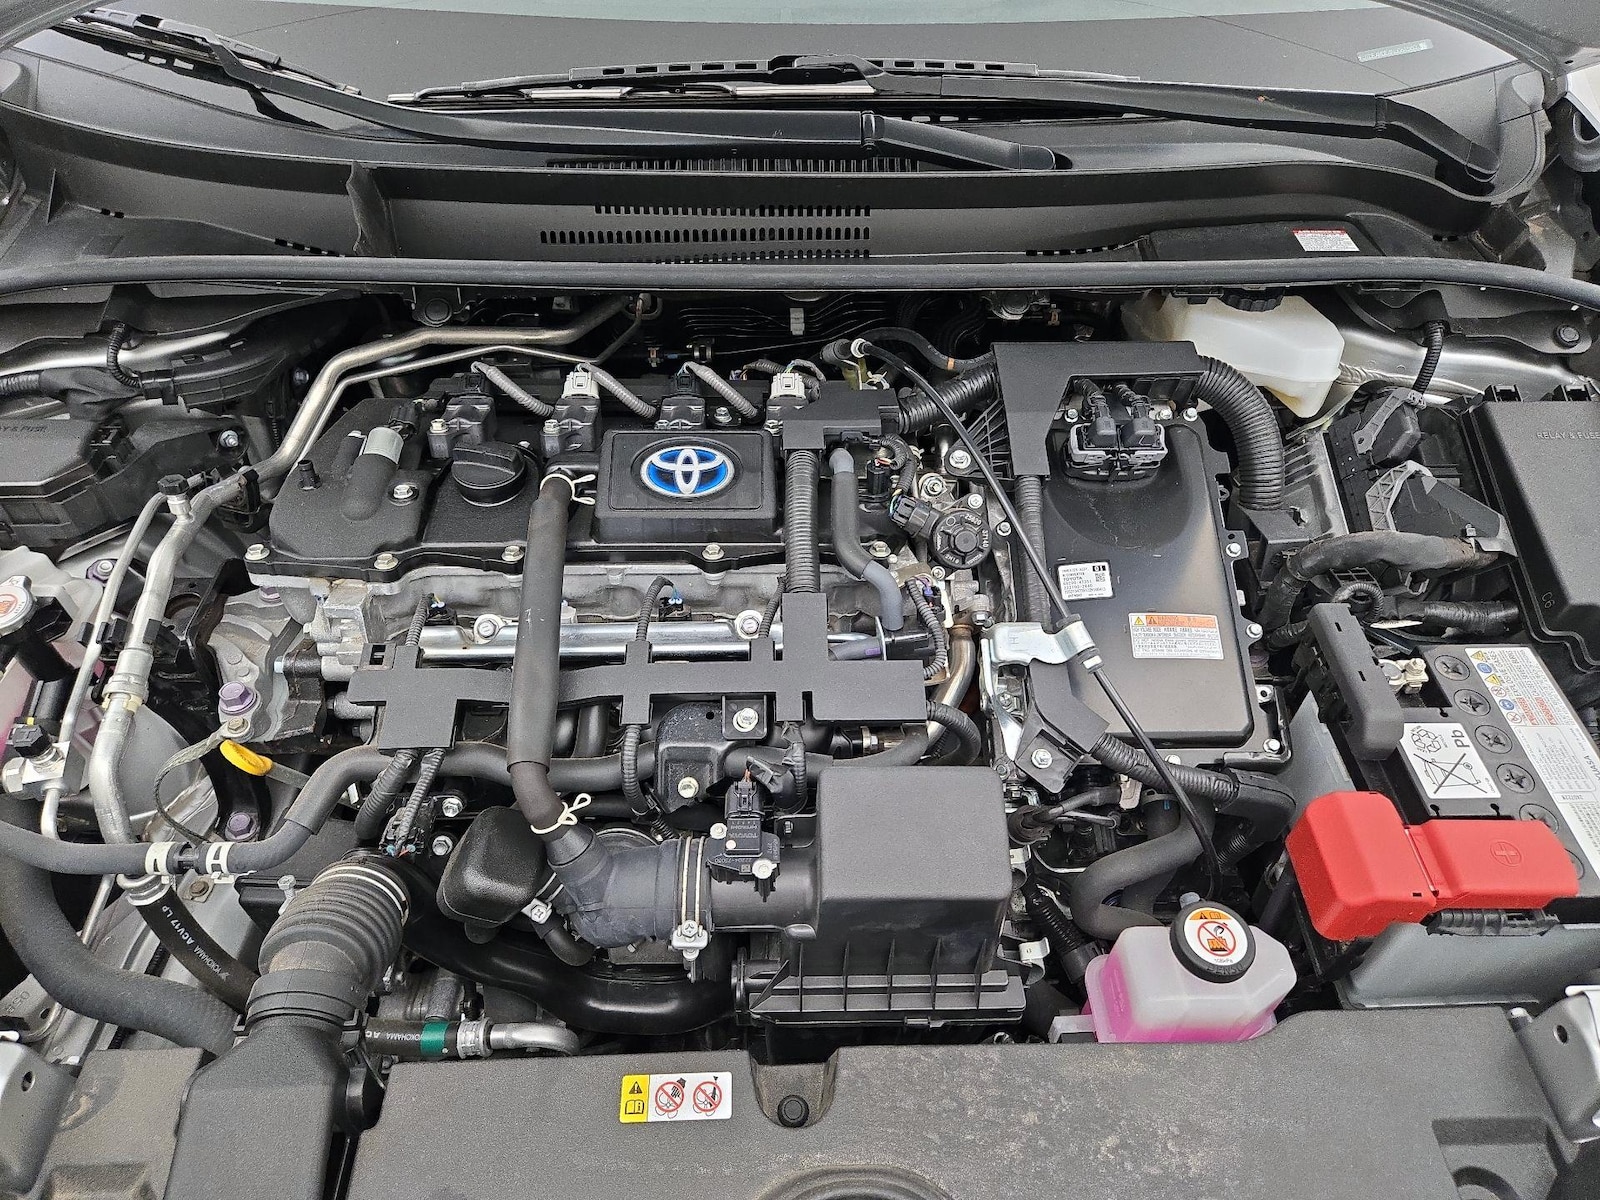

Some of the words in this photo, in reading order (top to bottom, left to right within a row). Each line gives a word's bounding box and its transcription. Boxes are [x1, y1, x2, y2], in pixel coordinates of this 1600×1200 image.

[1536, 430, 1566, 440] RELAY
[1569, 431, 1576, 439] &
[1577, 431, 1600, 439] FUSE
[1451, 729, 1471, 748] Pb
[161, 905, 174, 918] LP
[170, 919, 195, 945] ACV17
[193, 945, 222, 974] YOKOHAMA
